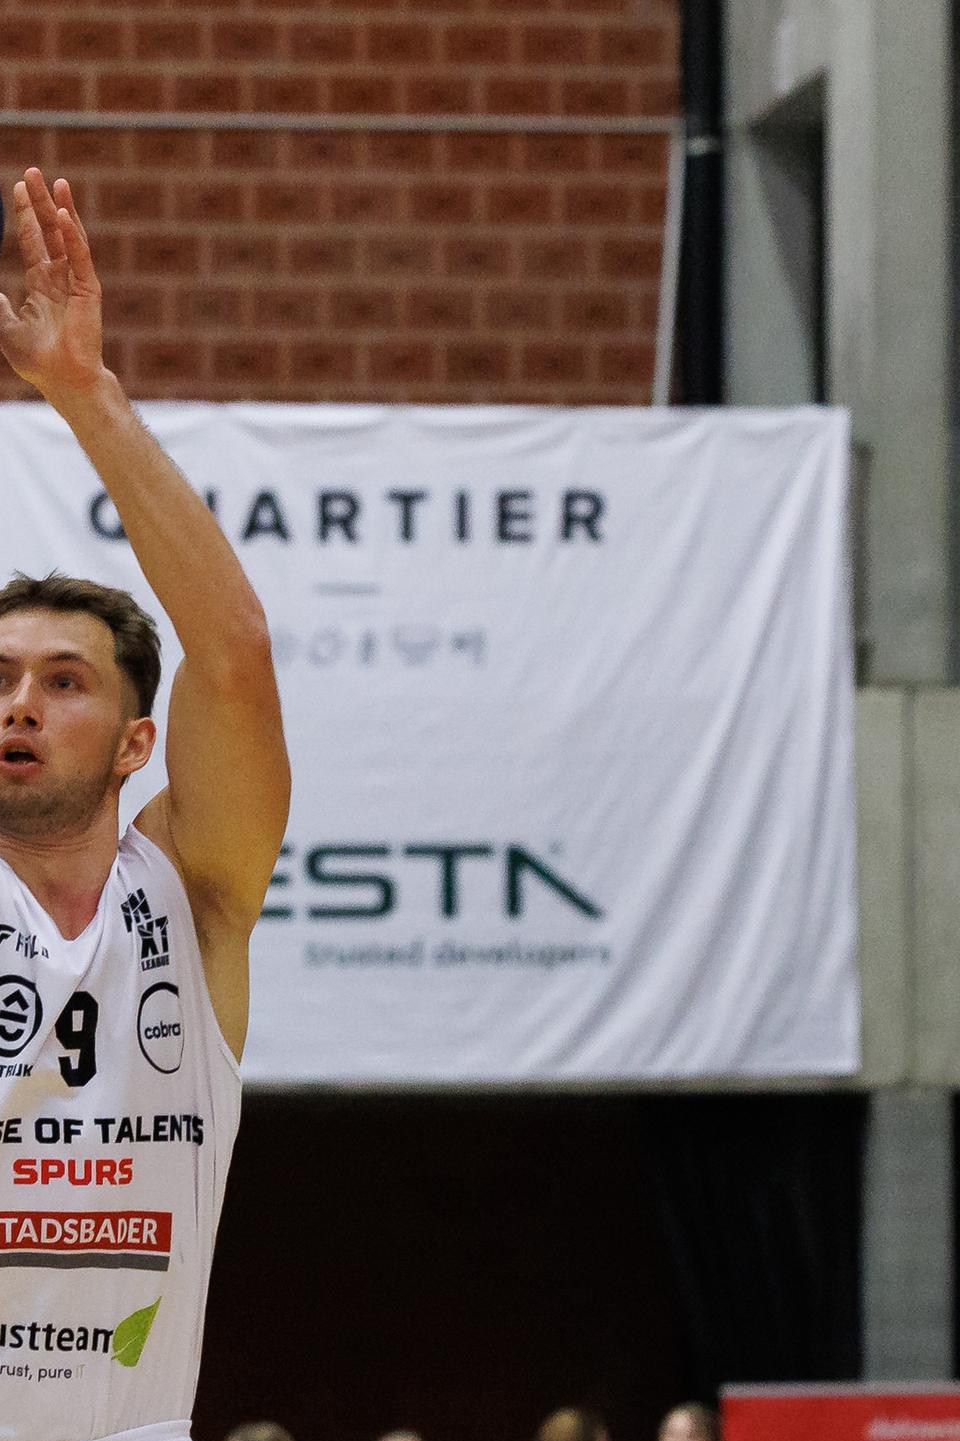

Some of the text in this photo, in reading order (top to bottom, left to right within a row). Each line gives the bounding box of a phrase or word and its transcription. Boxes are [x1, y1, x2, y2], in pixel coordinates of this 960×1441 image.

[88, 488, 606, 545] QARTIER
[141, 954, 170, 972] LEAGUE
[55, 991, 99, 1088] 9
[144, 1020, 181, 1040] cobra
[34, 1117, 84, 1144] OF
[94, 1114, 205, 1147] TALENTS
[12, 1158, 134, 1186] SPURS
[37, 1367, 73, 1382] pure
